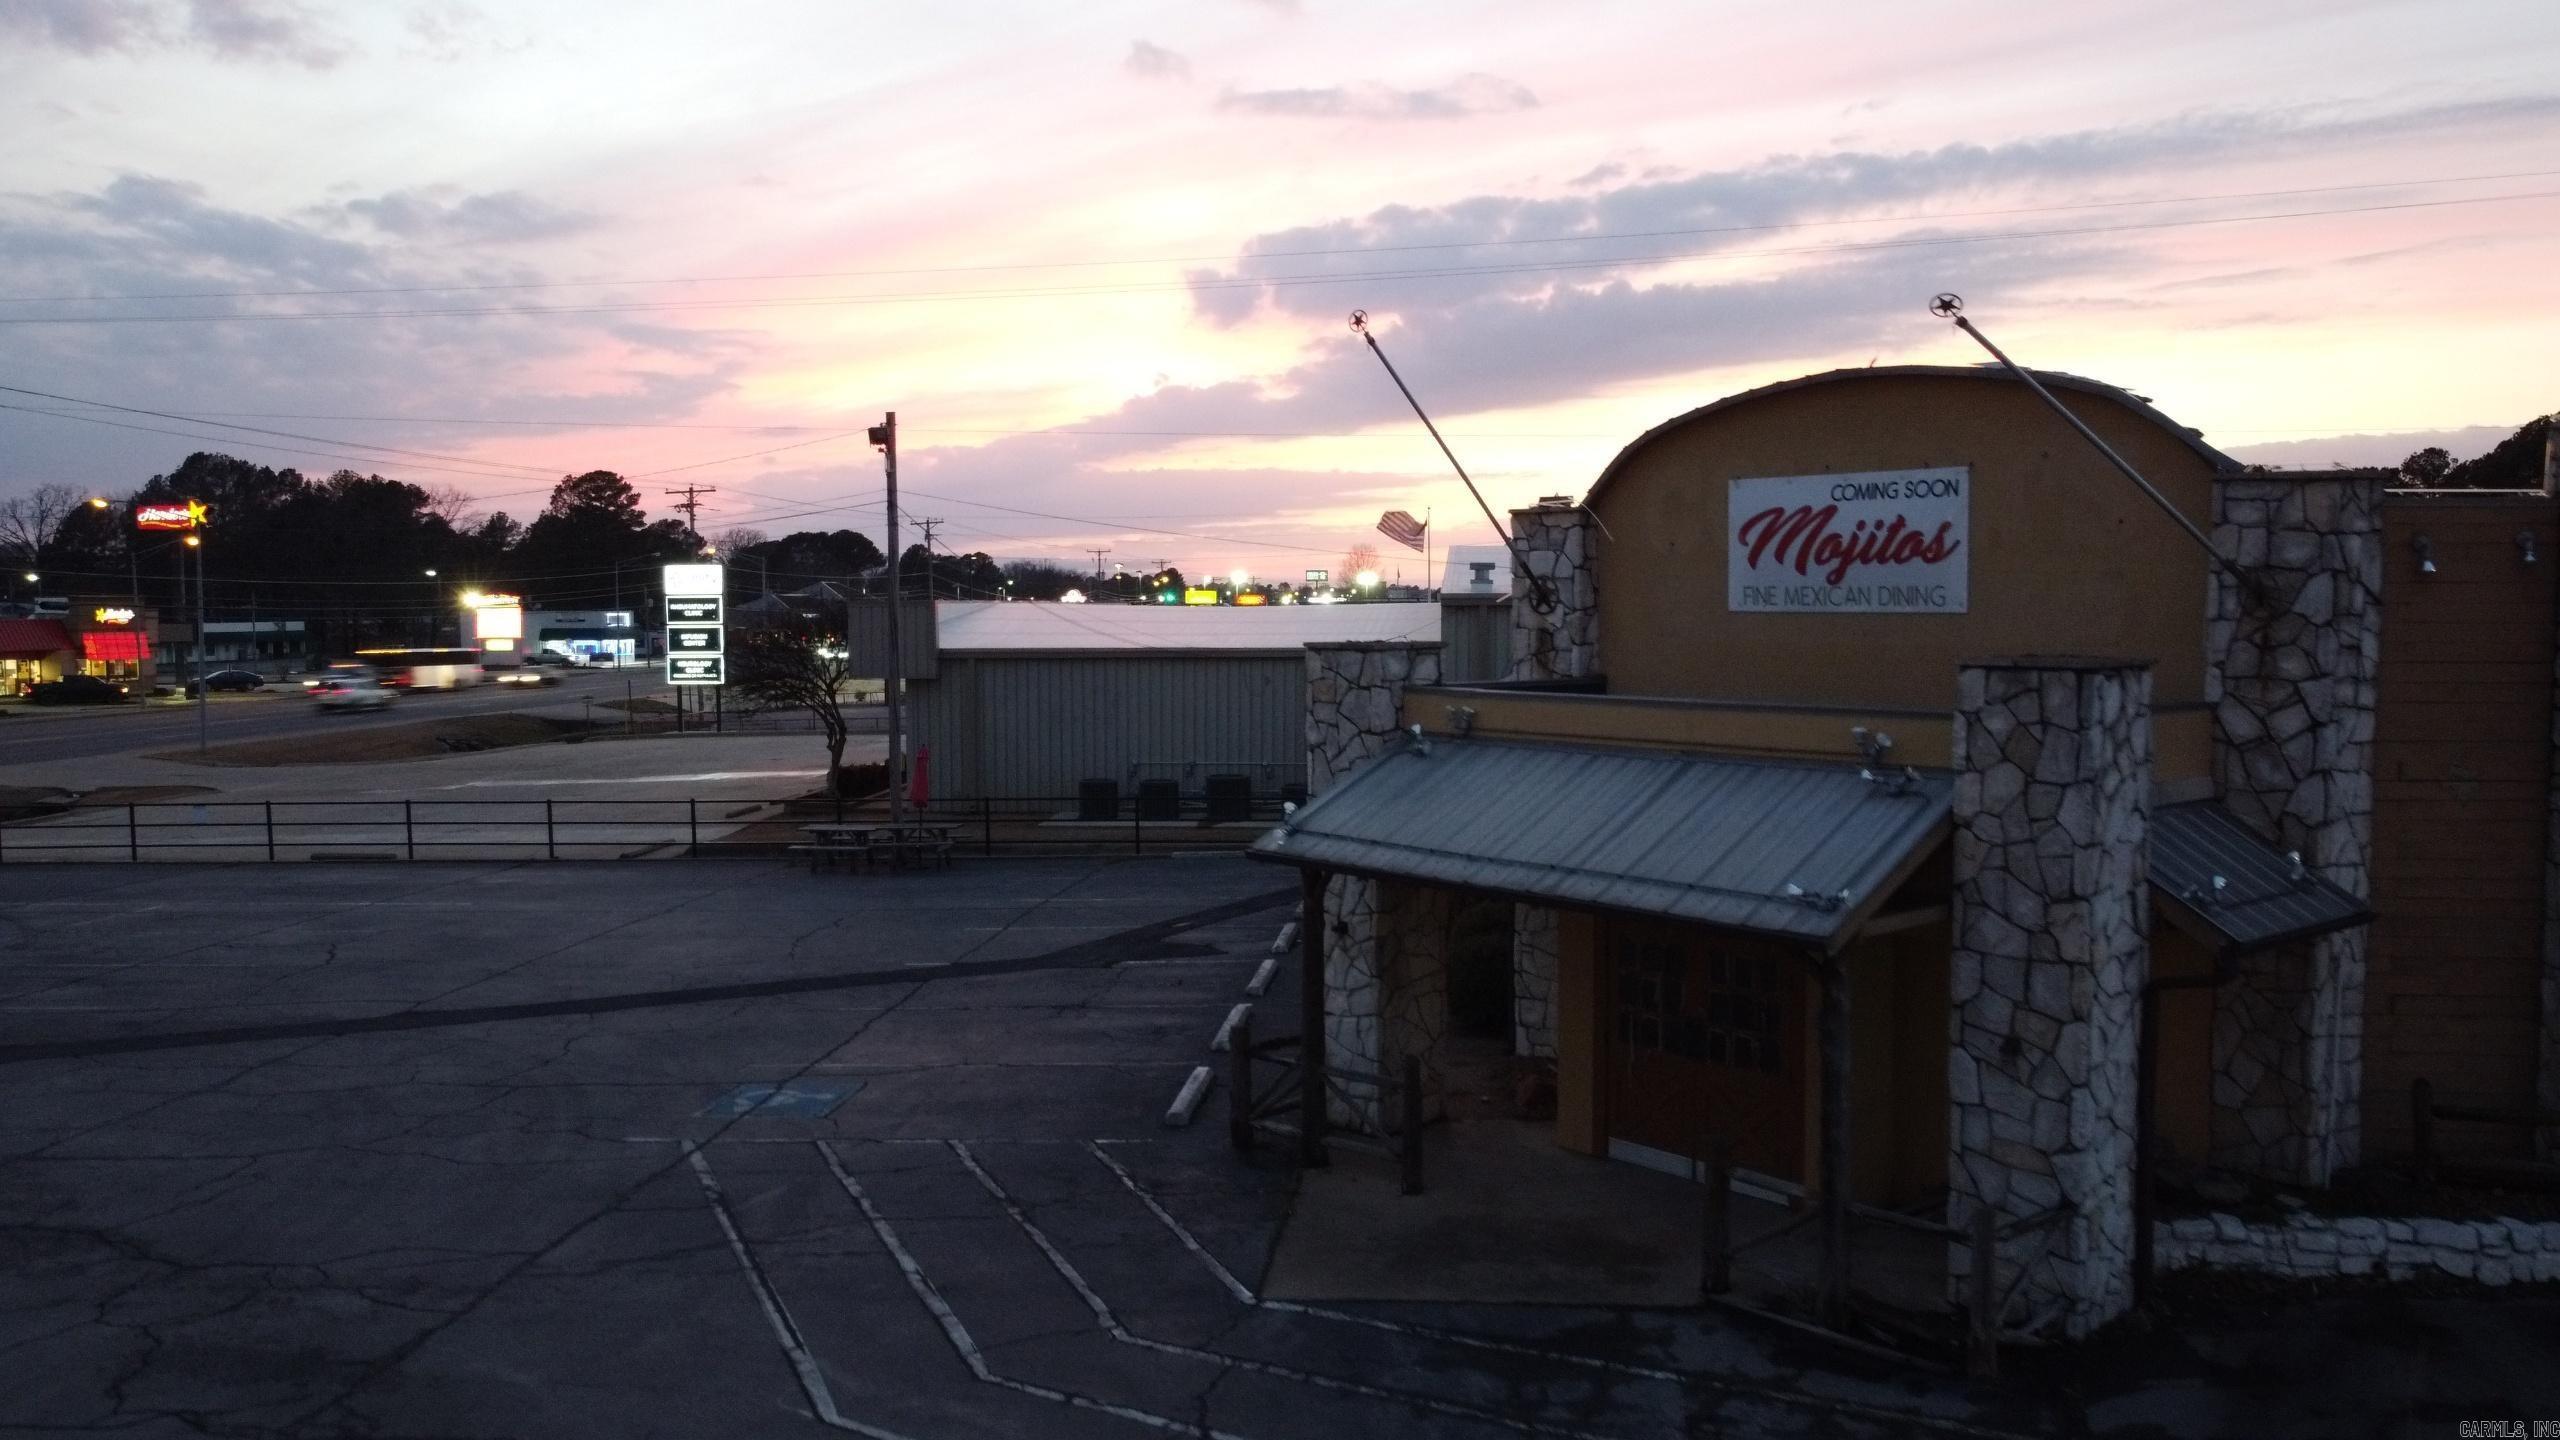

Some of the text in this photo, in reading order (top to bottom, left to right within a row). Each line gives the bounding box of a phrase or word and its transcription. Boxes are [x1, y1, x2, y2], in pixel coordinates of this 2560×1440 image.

[1831, 479, 1960, 502] COMING SOON
[1738, 504, 1961, 586] Mojitos
[1743, 586, 1946, 607] FINE MEXICAN DINING
